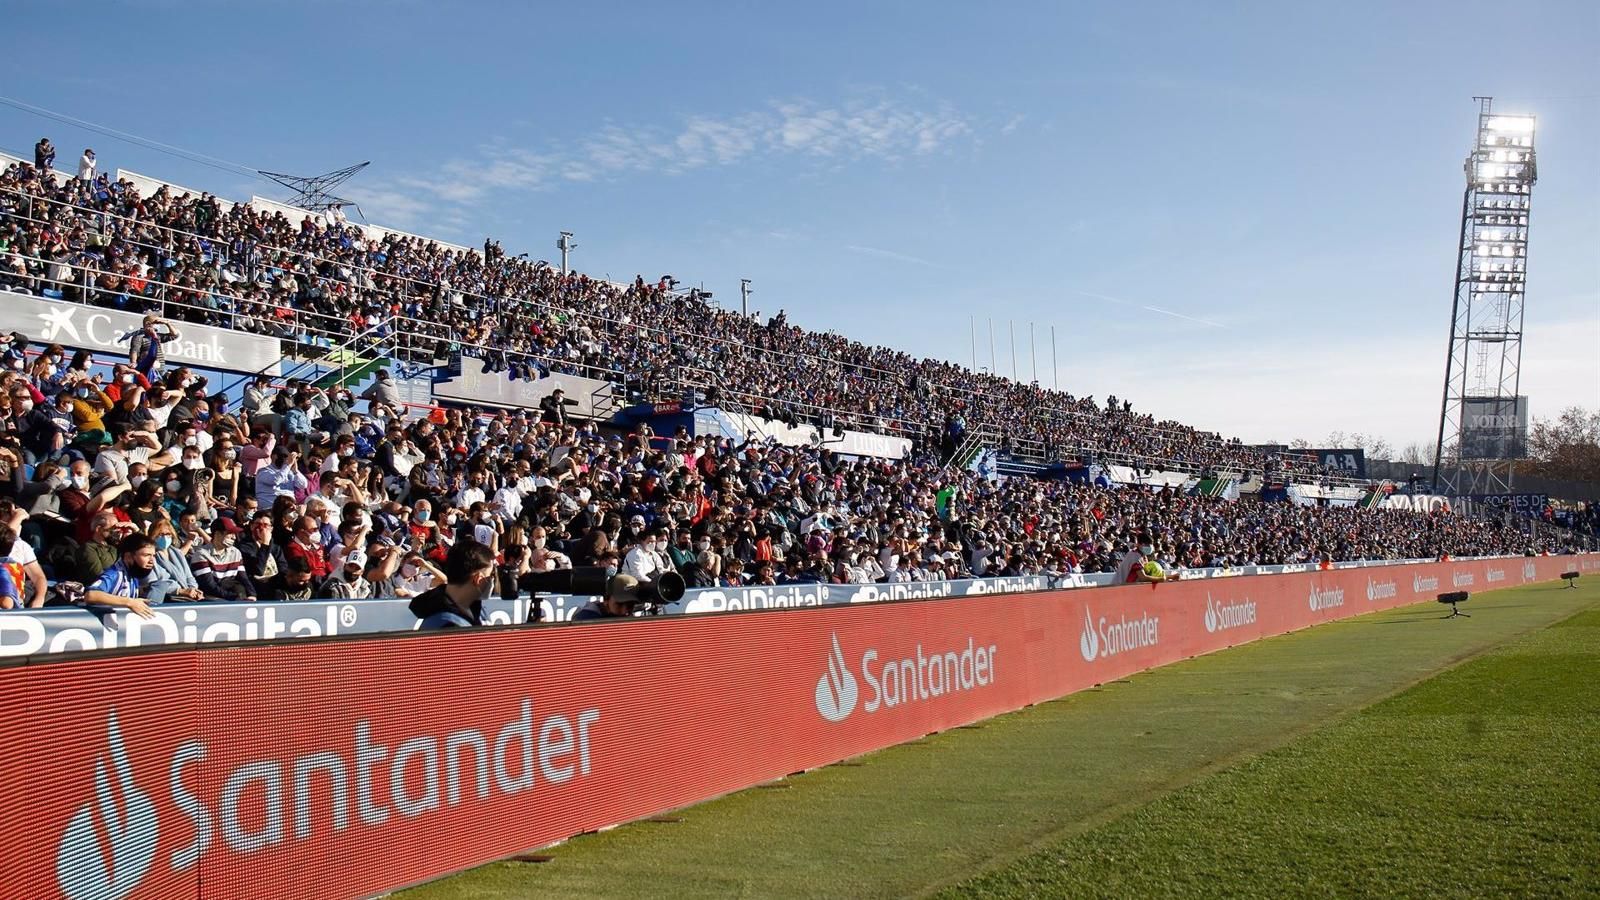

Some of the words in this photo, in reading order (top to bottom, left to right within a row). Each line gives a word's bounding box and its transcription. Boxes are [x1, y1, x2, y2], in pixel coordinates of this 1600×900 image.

[86, 314, 228, 363] CaBank
[1216, 596, 1257, 630] Santander
[1316, 585, 1345, 609] Santander
[1099, 610, 1159, 657] Santander
[862, 636, 997, 713] Santander
[168, 696, 600, 873] Santander
